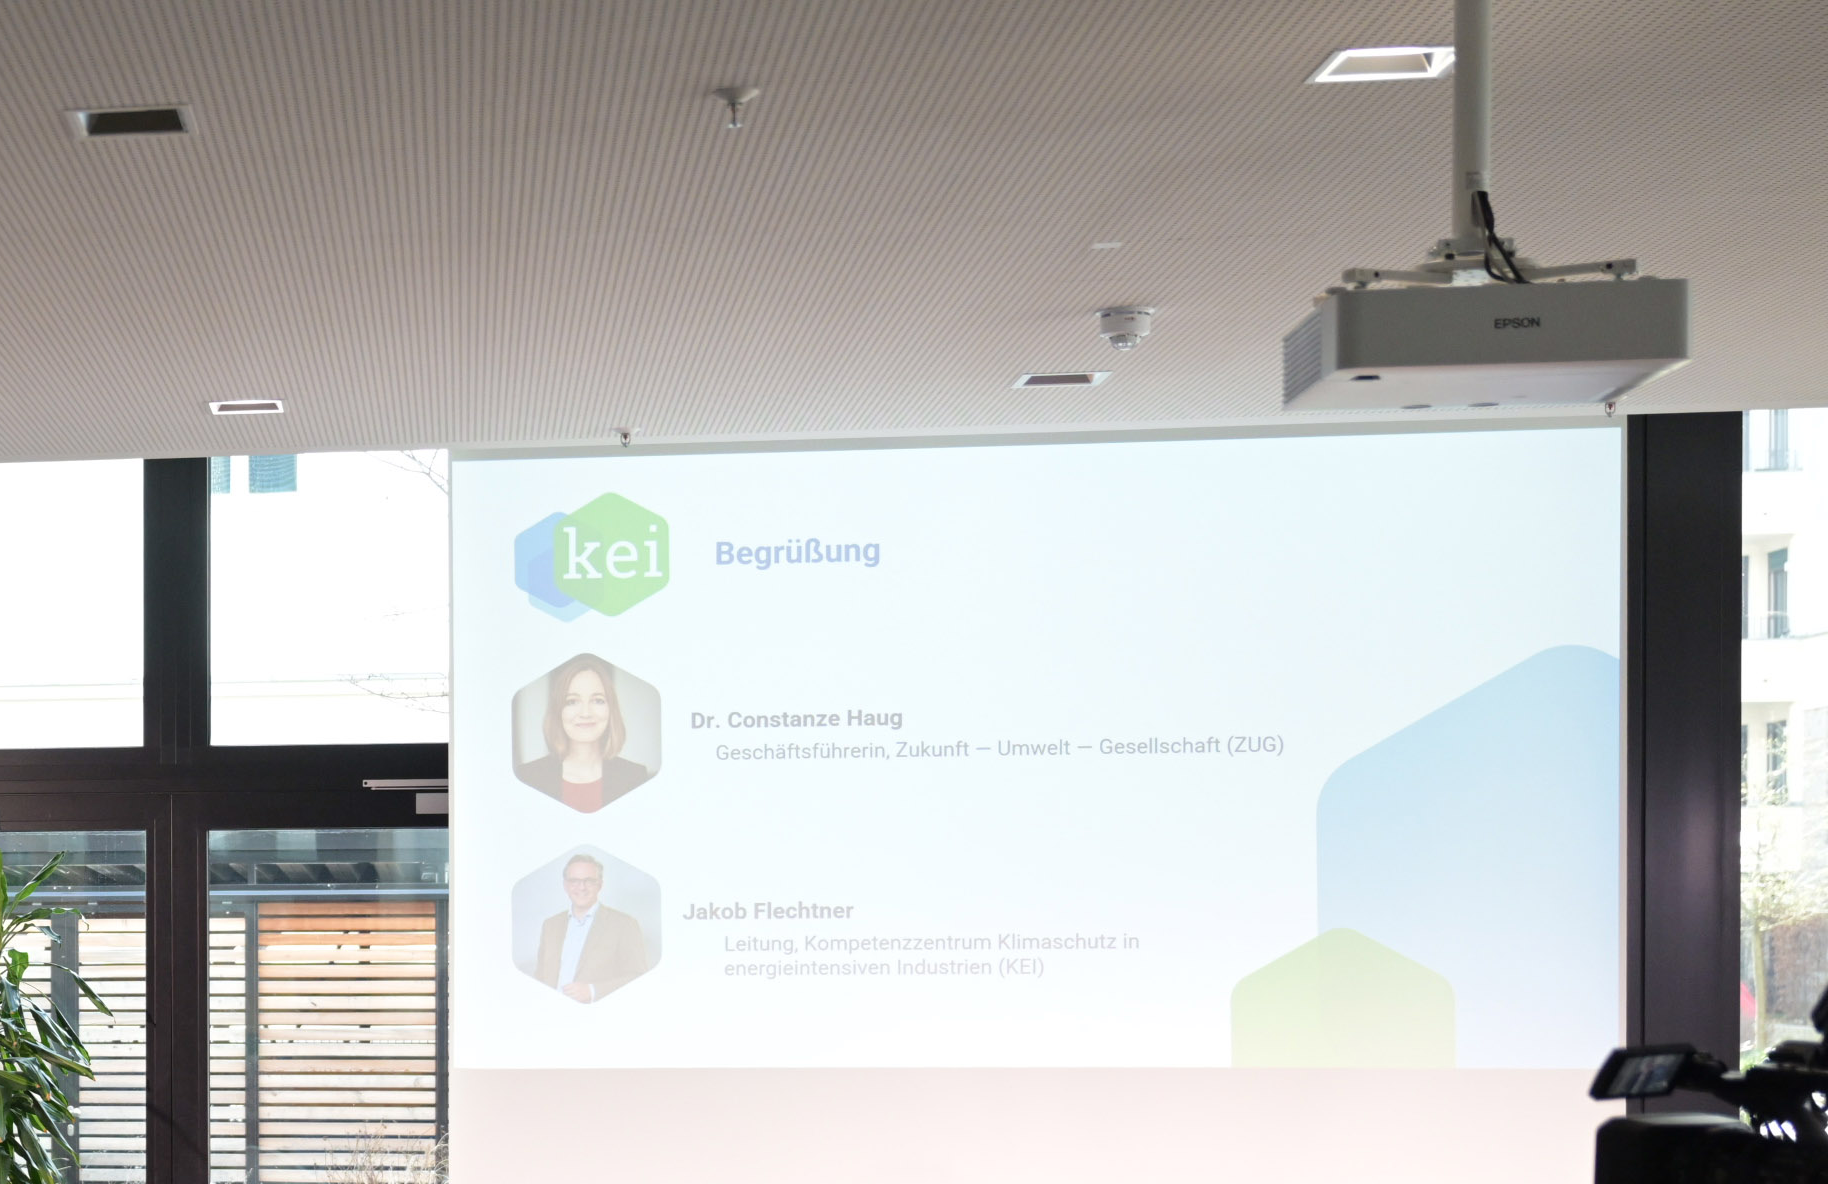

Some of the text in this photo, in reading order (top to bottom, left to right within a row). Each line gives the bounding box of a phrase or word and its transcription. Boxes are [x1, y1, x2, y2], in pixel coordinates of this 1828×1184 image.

[1494, 317, 1541, 329] EPSON
[562, 525, 663, 580] kei
[715, 537, 881, 571] Begrüßung
[691, 708, 903, 731] Dr. Constanze Haug
[715, 741, 891, 761] Geschäftsführerin,
[895, 739, 970, 758] Zukunft
[997, 738, 1071, 757] Umwelt
[1099, 735, 1221, 755] Gesellschaft
[1227, 734, 1285, 758] (ZUG)
[682, 900, 855, 921] Jakob Flechtner
[724, 932, 1140, 956] Leitung, Kompetenzzentrum Klimaschutz in
[723, 956, 1045, 980] energieintensiven Industrien (KEI)
